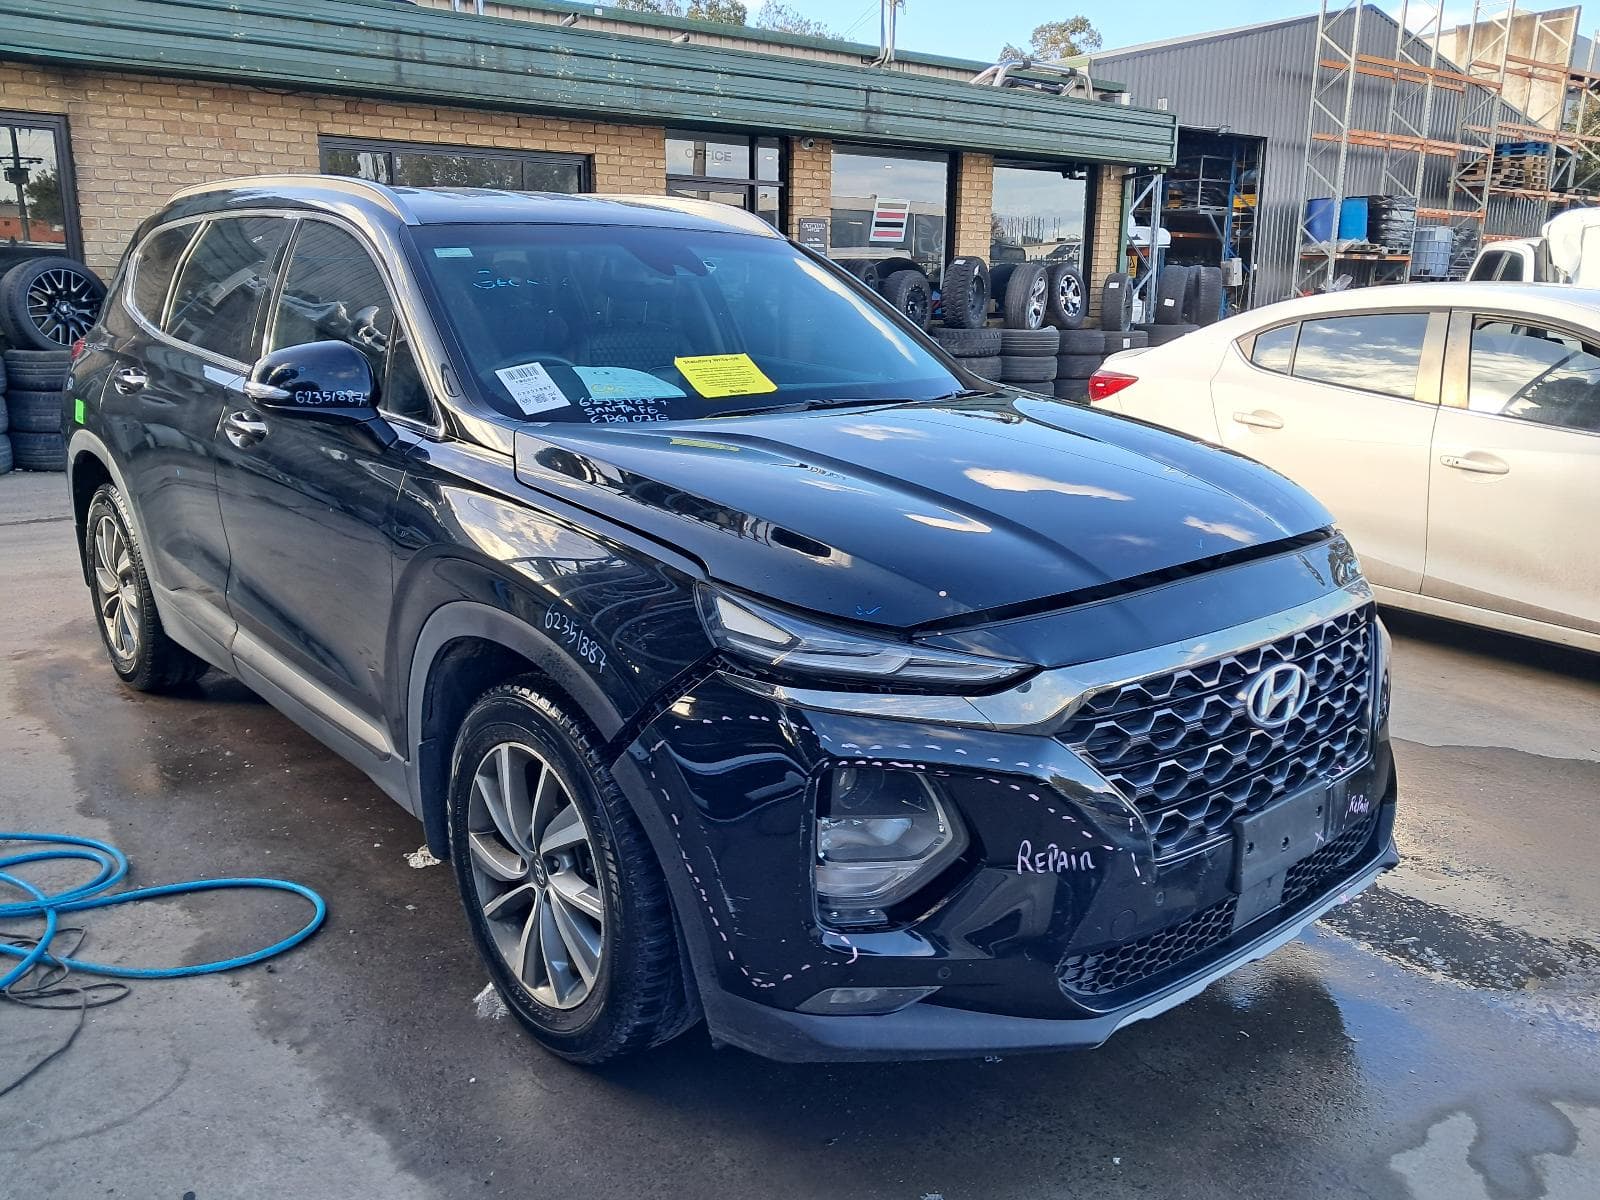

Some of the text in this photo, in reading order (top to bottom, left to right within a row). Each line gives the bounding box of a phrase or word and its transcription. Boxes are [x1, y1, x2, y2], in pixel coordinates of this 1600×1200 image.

[685, 148, 732, 162] OFFICE
[295, 389, 368, 407] 62351887
[544, 603, 607, 674] 62351887
